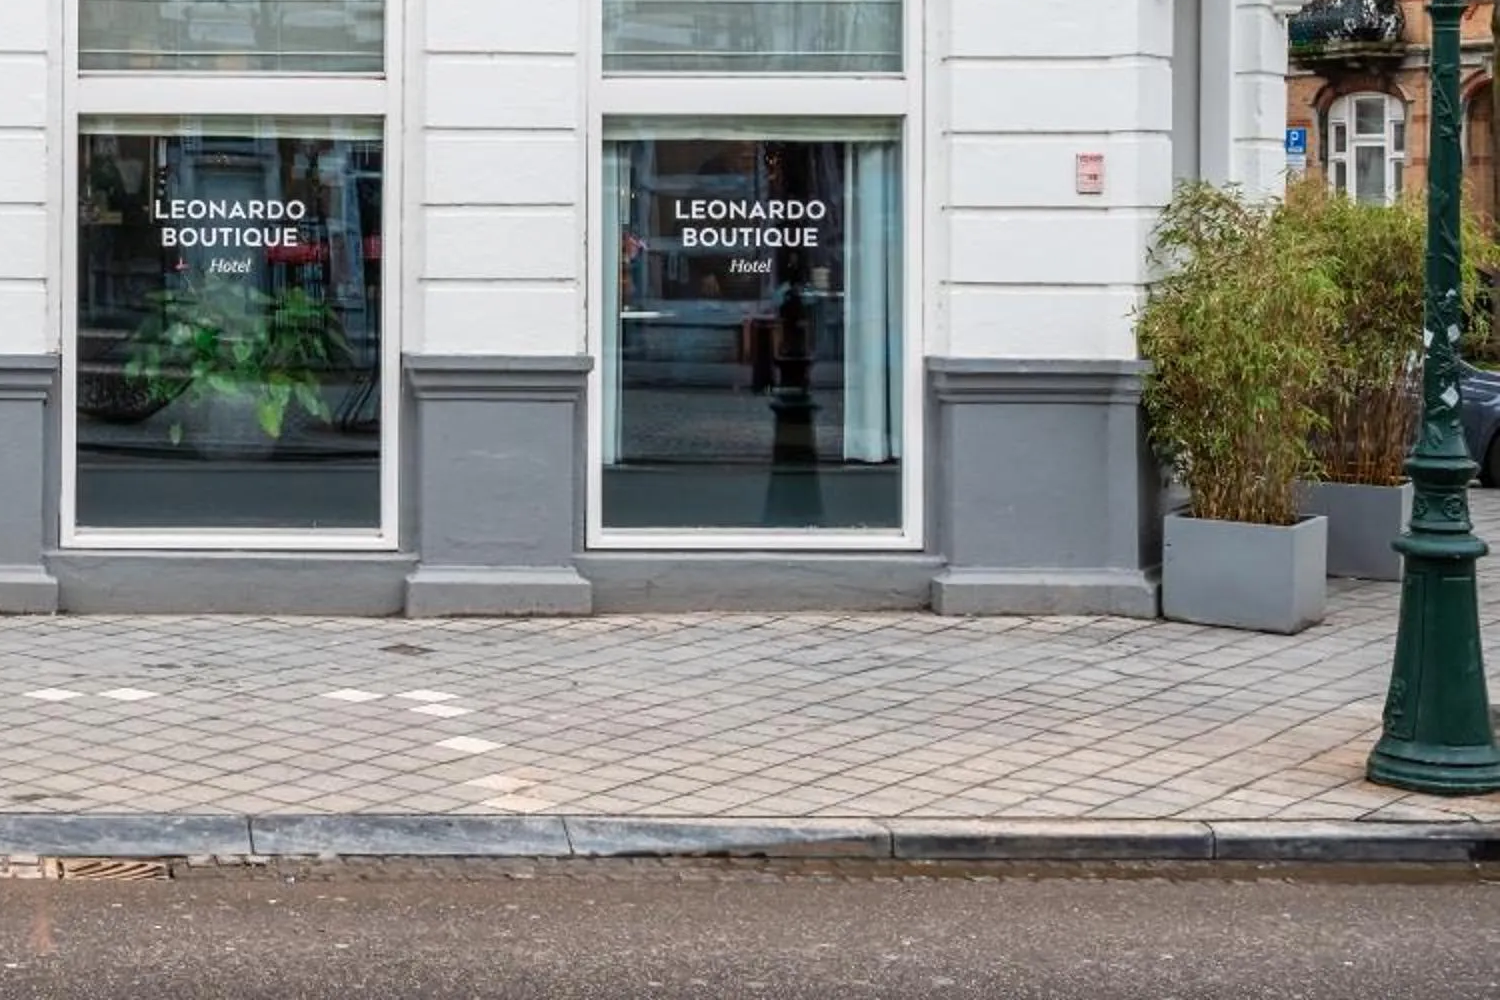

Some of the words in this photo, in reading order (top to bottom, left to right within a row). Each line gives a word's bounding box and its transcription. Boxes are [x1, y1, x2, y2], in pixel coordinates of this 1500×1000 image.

[156, 199, 306, 220] LEONARDO
[675, 199, 826, 219] LEONARDO
[162, 227, 298, 248] BOUTIQUE
[683, 227, 819, 248] BOUTIQUE
[209, 256, 252, 274] Hotel
[729, 257, 772, 274] Hotel
